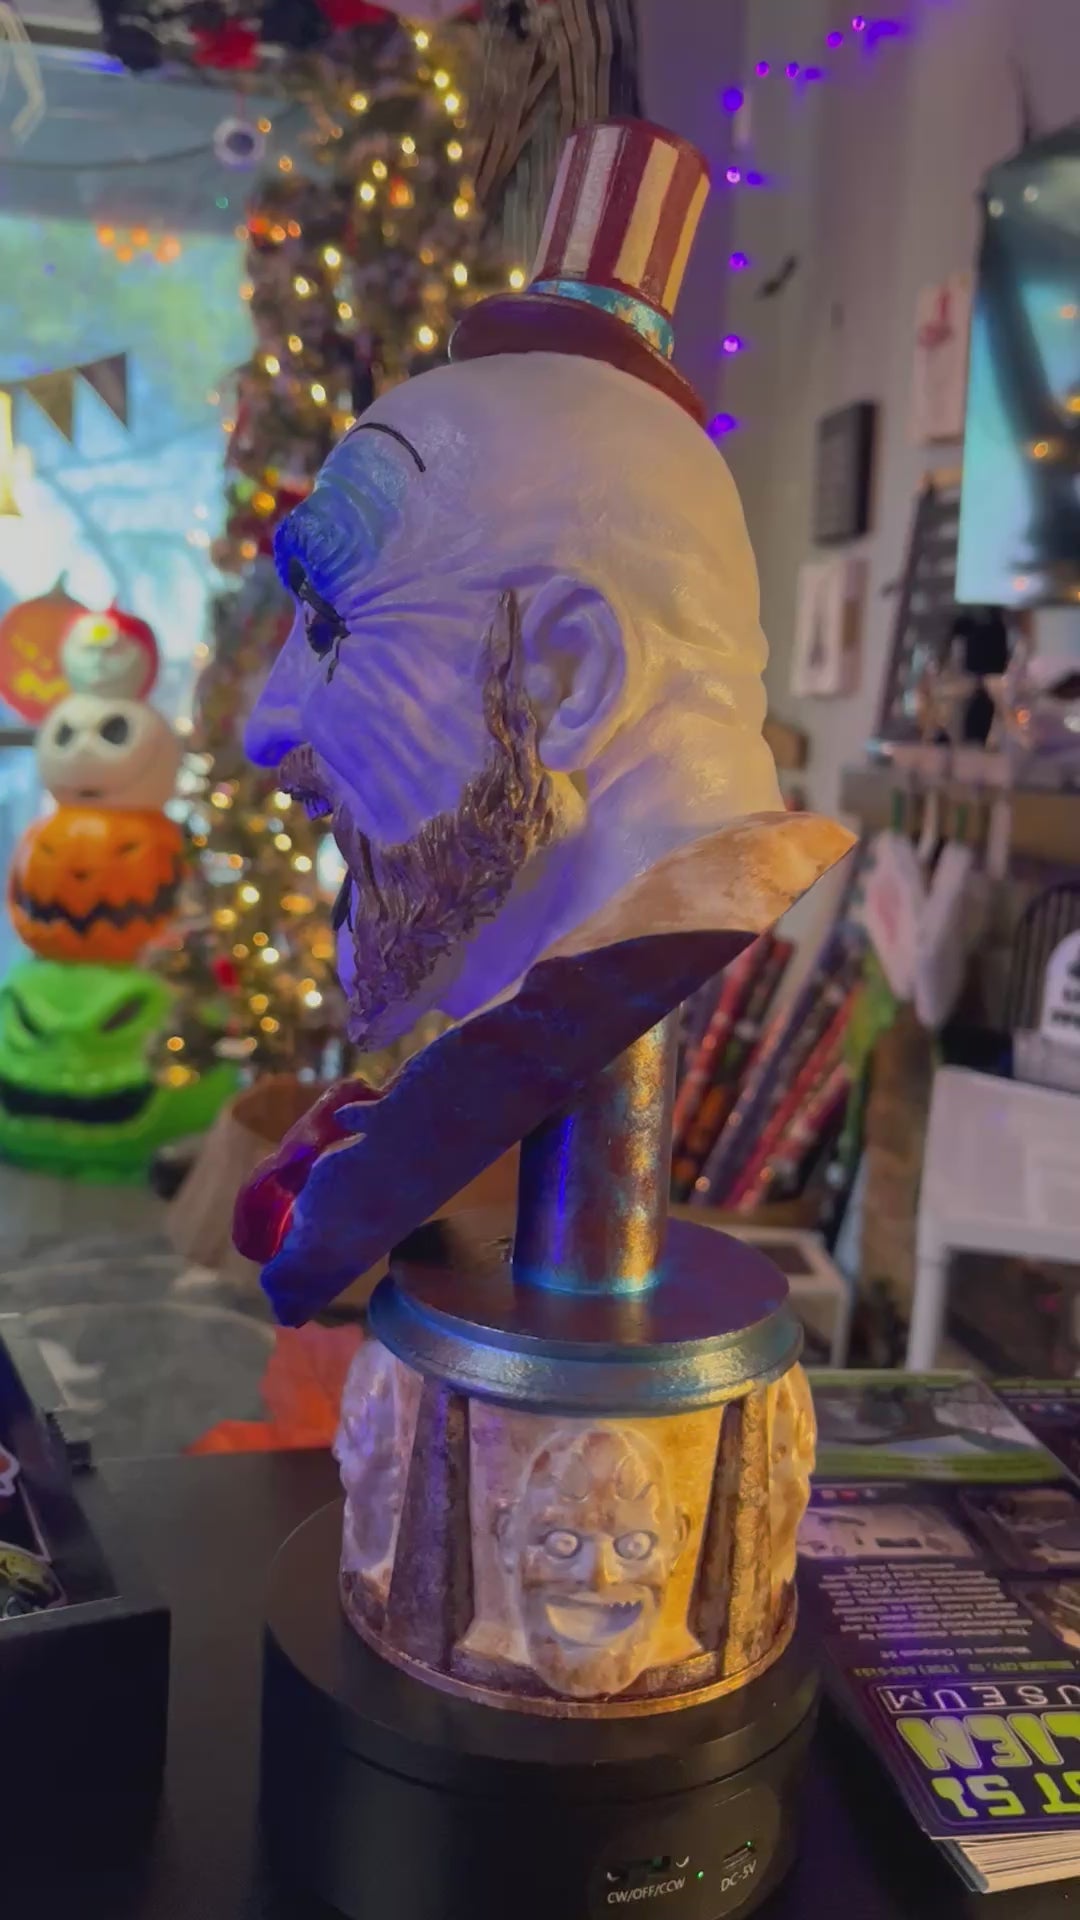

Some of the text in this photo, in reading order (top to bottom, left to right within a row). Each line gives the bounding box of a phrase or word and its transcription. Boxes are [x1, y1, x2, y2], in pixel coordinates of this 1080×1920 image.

[931, 1776, 1026, 1817] 51
[607, 1877, 686, 1904] CW/OFF/CCW
[720, 1860, 757, 1892] DC-5V
